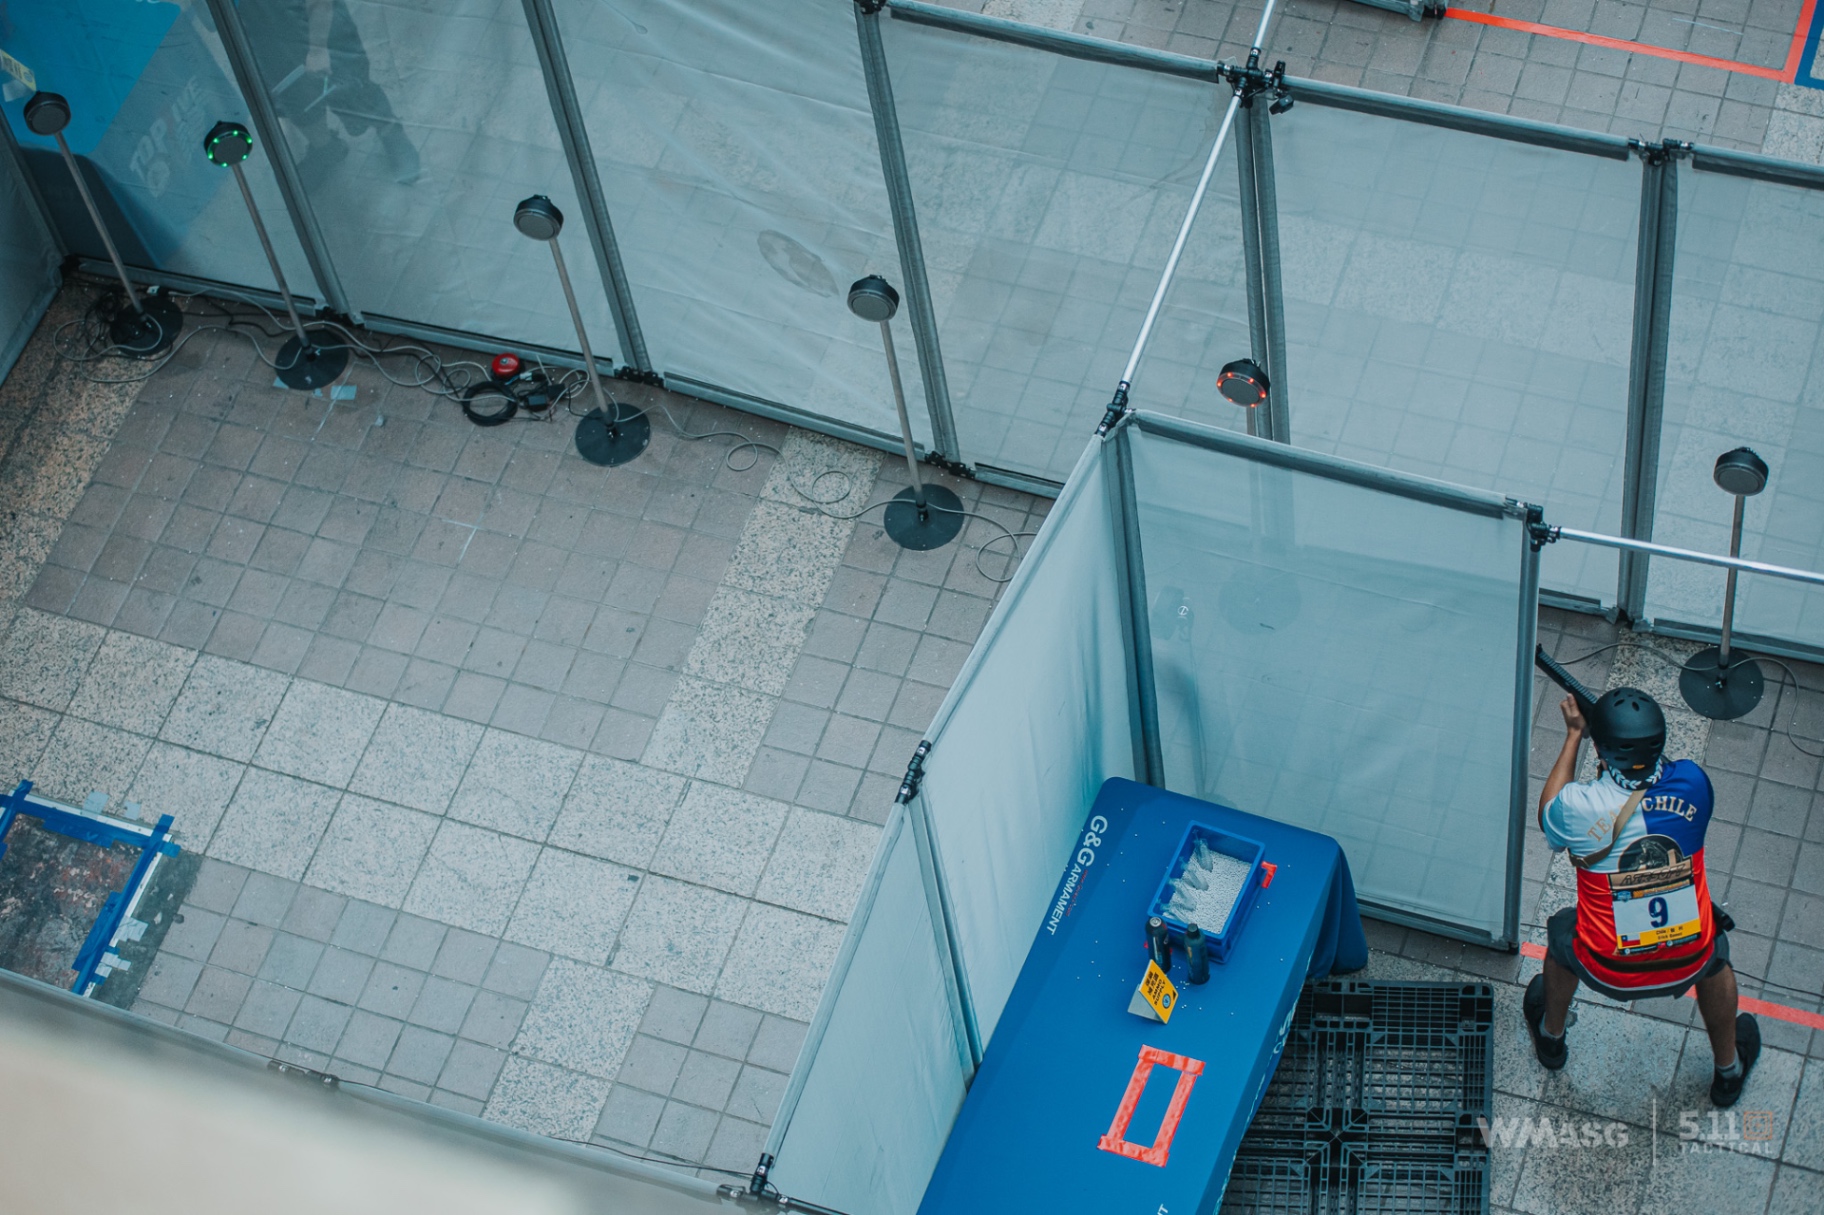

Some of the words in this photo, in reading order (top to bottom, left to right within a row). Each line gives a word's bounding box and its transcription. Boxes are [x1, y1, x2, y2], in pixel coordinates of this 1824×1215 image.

[1077, 815, 1108, 867] G&G
[1587, 804, 1637, 842] TEA
[1641, 795, 1697, 822] CHILE
[1046, 863, 1082, 935] ARMAMENT
[1648, 897, 1668, 928] 9
